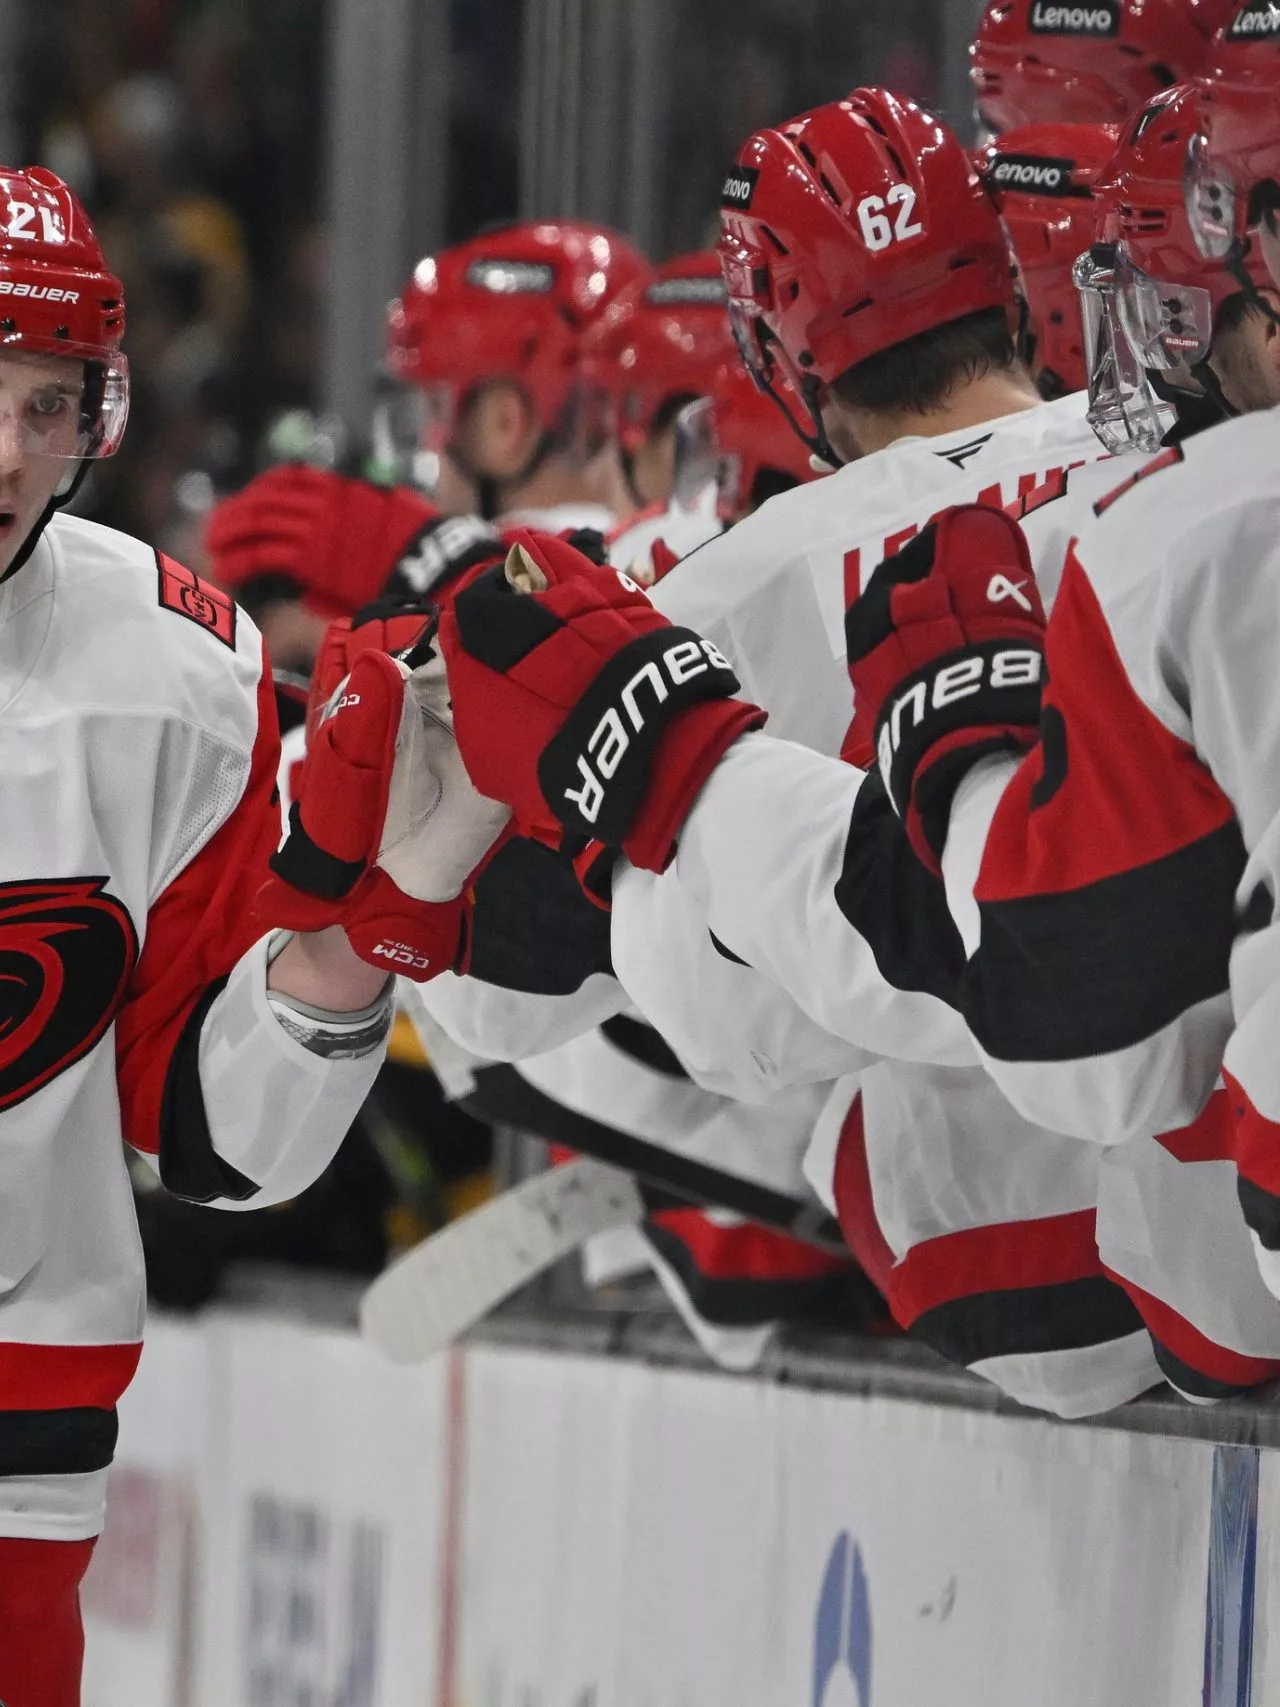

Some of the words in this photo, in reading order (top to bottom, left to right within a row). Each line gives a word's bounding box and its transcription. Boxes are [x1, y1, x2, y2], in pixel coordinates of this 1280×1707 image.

[1033, 4, 1112, 30] Lenovo
[1232, 9, 1280, 33] Lenov
[7, 200, 58, 243] 21
[857, 183, 922, 251] 62
[372, 944, 430, 969] CCM
